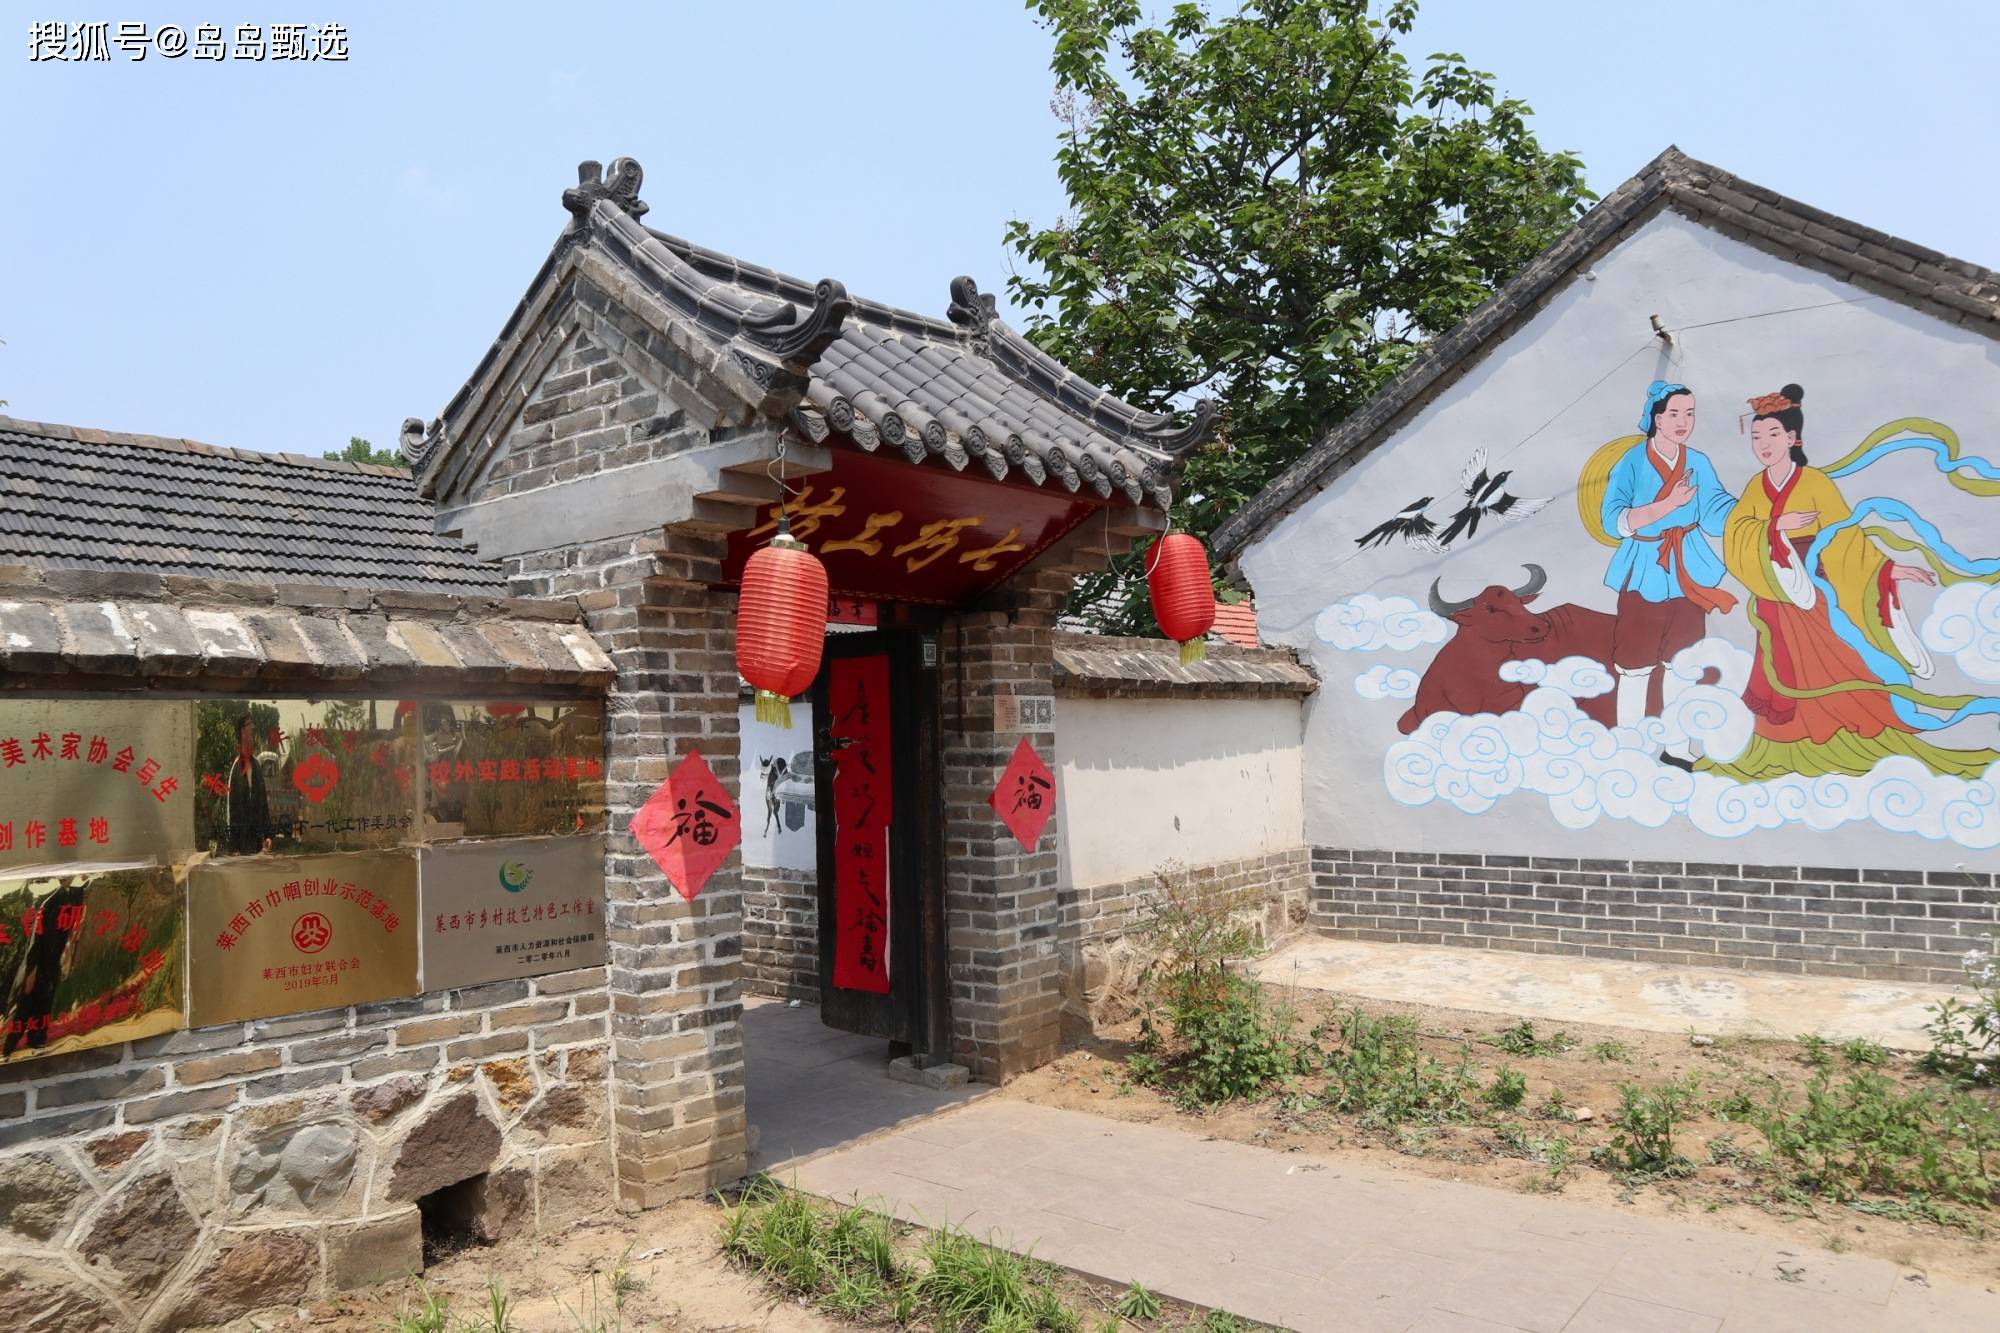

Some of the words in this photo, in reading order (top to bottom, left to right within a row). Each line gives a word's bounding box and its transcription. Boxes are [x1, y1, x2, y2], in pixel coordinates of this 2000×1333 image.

[1011, 770, 1051, 814] 福
[663, 790, 732, 848] 福
[215, 878, 400, 952] 莱西市巾帼创业示范基地
[434, 897, 596, 934] 莱西市乡村技艺特色工作室
[495, 932, 595, 954] 莱西市人力资源和社会保障局
[517, 949, 571, 965] 二零二零年八月
[261, 956, 362, 981] 莱西市妇女联合会
[284, 973, 340, 991] 2019年5月
